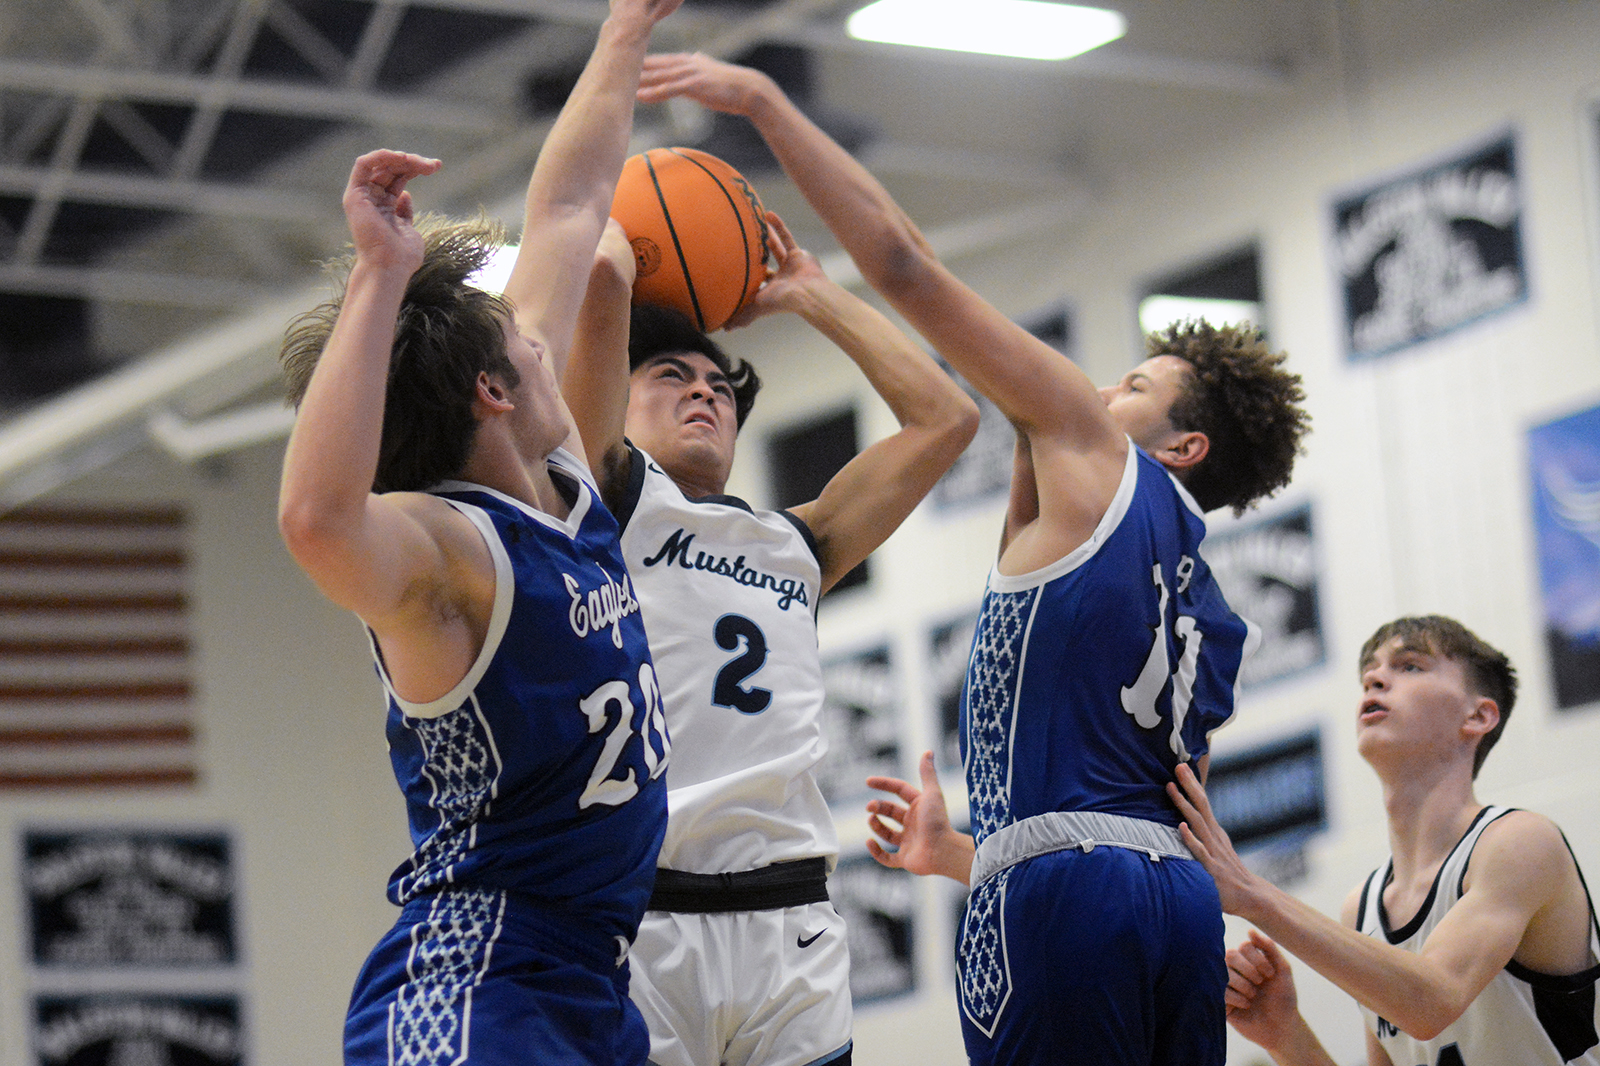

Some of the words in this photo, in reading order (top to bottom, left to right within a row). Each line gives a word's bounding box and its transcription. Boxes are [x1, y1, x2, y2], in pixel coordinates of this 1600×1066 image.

[562, 561, 639, 649] Eagles
[643, 528, 808, 611] Mustangs
[711, 612, 773, 716] 2
[578, 662, 671, 810] 20
